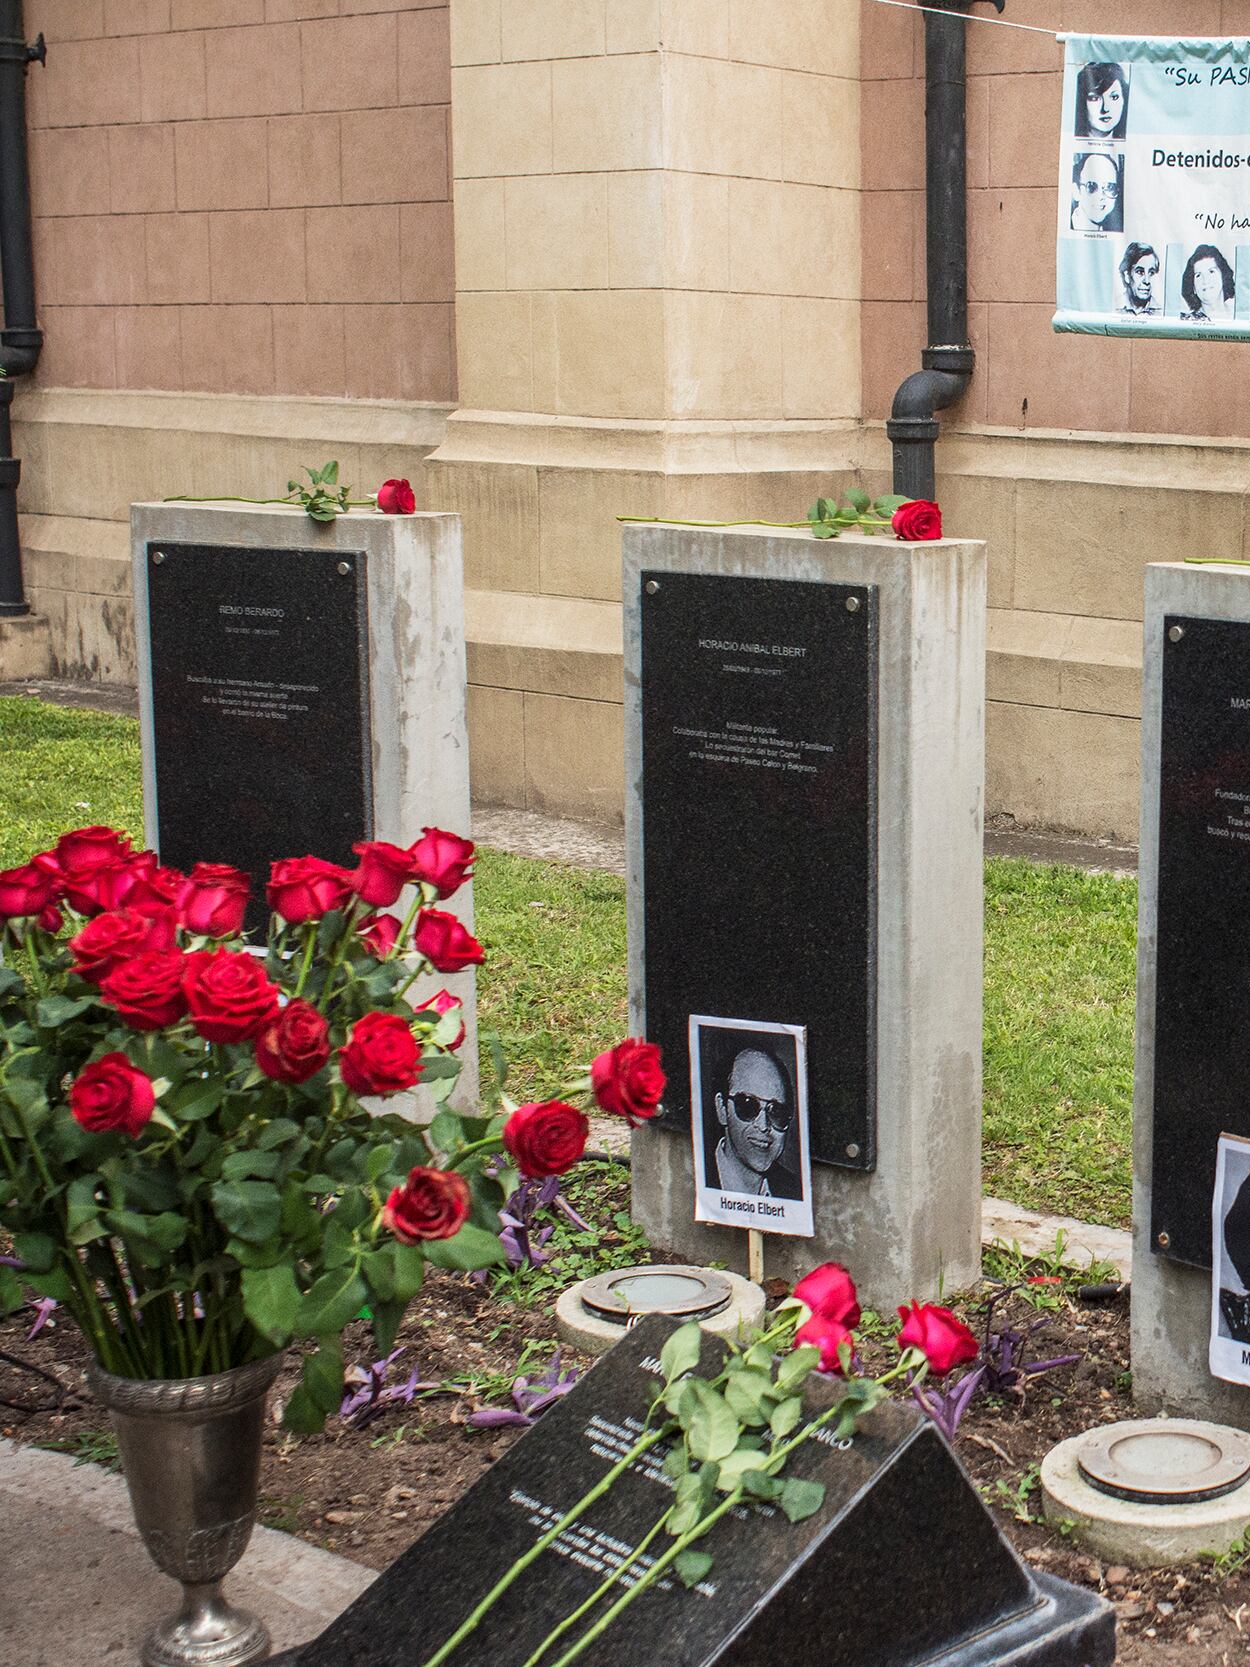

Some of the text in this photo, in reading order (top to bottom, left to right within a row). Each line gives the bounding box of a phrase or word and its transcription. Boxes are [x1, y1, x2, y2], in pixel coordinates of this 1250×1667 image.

[1165, 67, 1201, 86] “Su
[1194, 213, 1225, 230] “No
[698, 638, 739, 651] HORACIO
[772, 645, 807, 657] ELBERT
[1227, 815, 1244, 827] Tras
[1230, 831, 1235, 840] y
[720, 1196, 785, 1218] Horacio Elbert
[804, 1422, 854, 1450] ANCO
